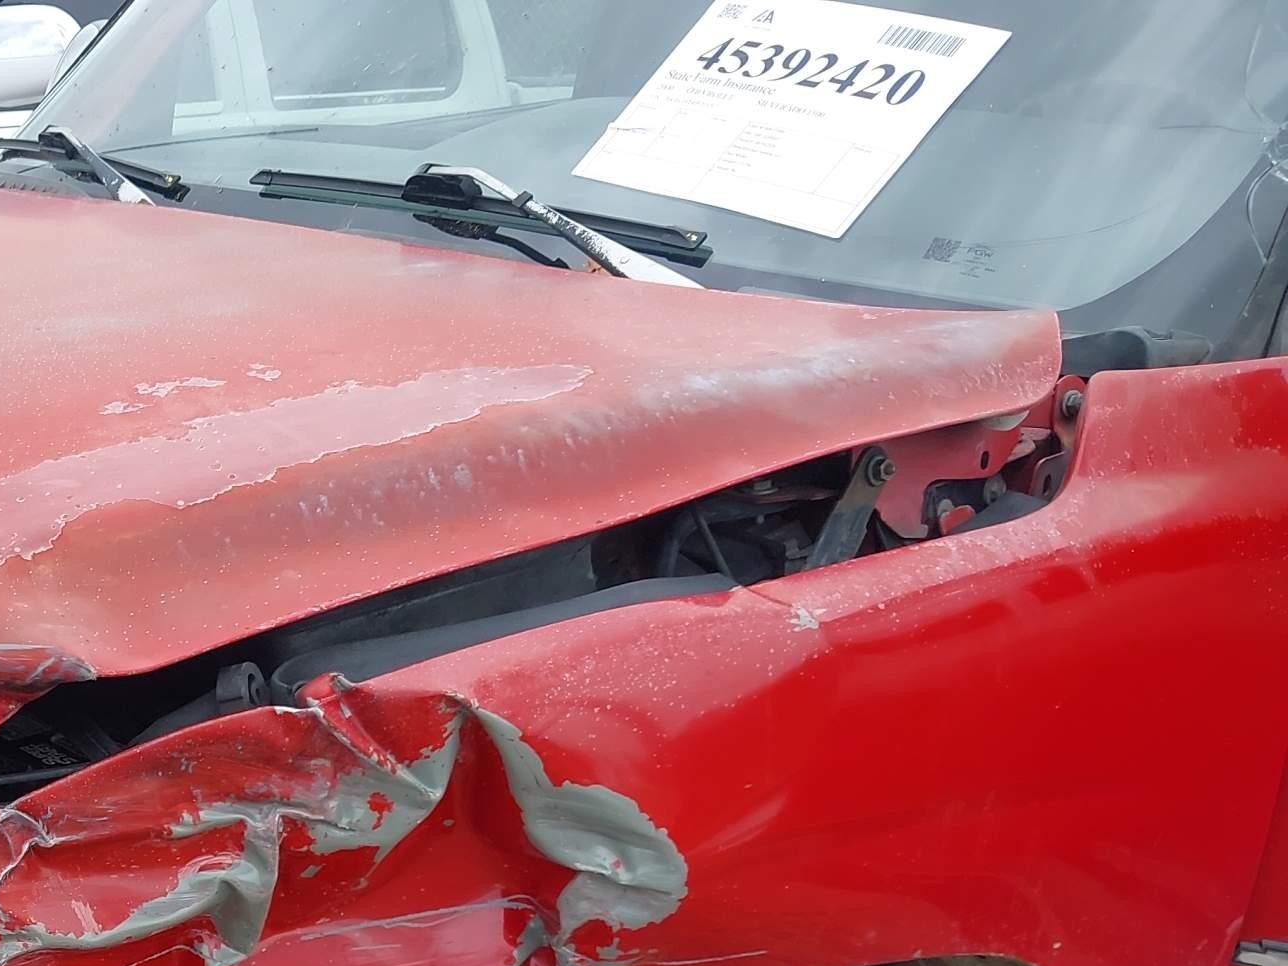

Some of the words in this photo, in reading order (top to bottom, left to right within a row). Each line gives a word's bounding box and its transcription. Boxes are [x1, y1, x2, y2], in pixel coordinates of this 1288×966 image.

[666, 70, 692, 82] State
[693, 72, 721, 86] Farm
[721, 77, 777, 96] Insurance
[697, 37, 926, 106] 45392420
